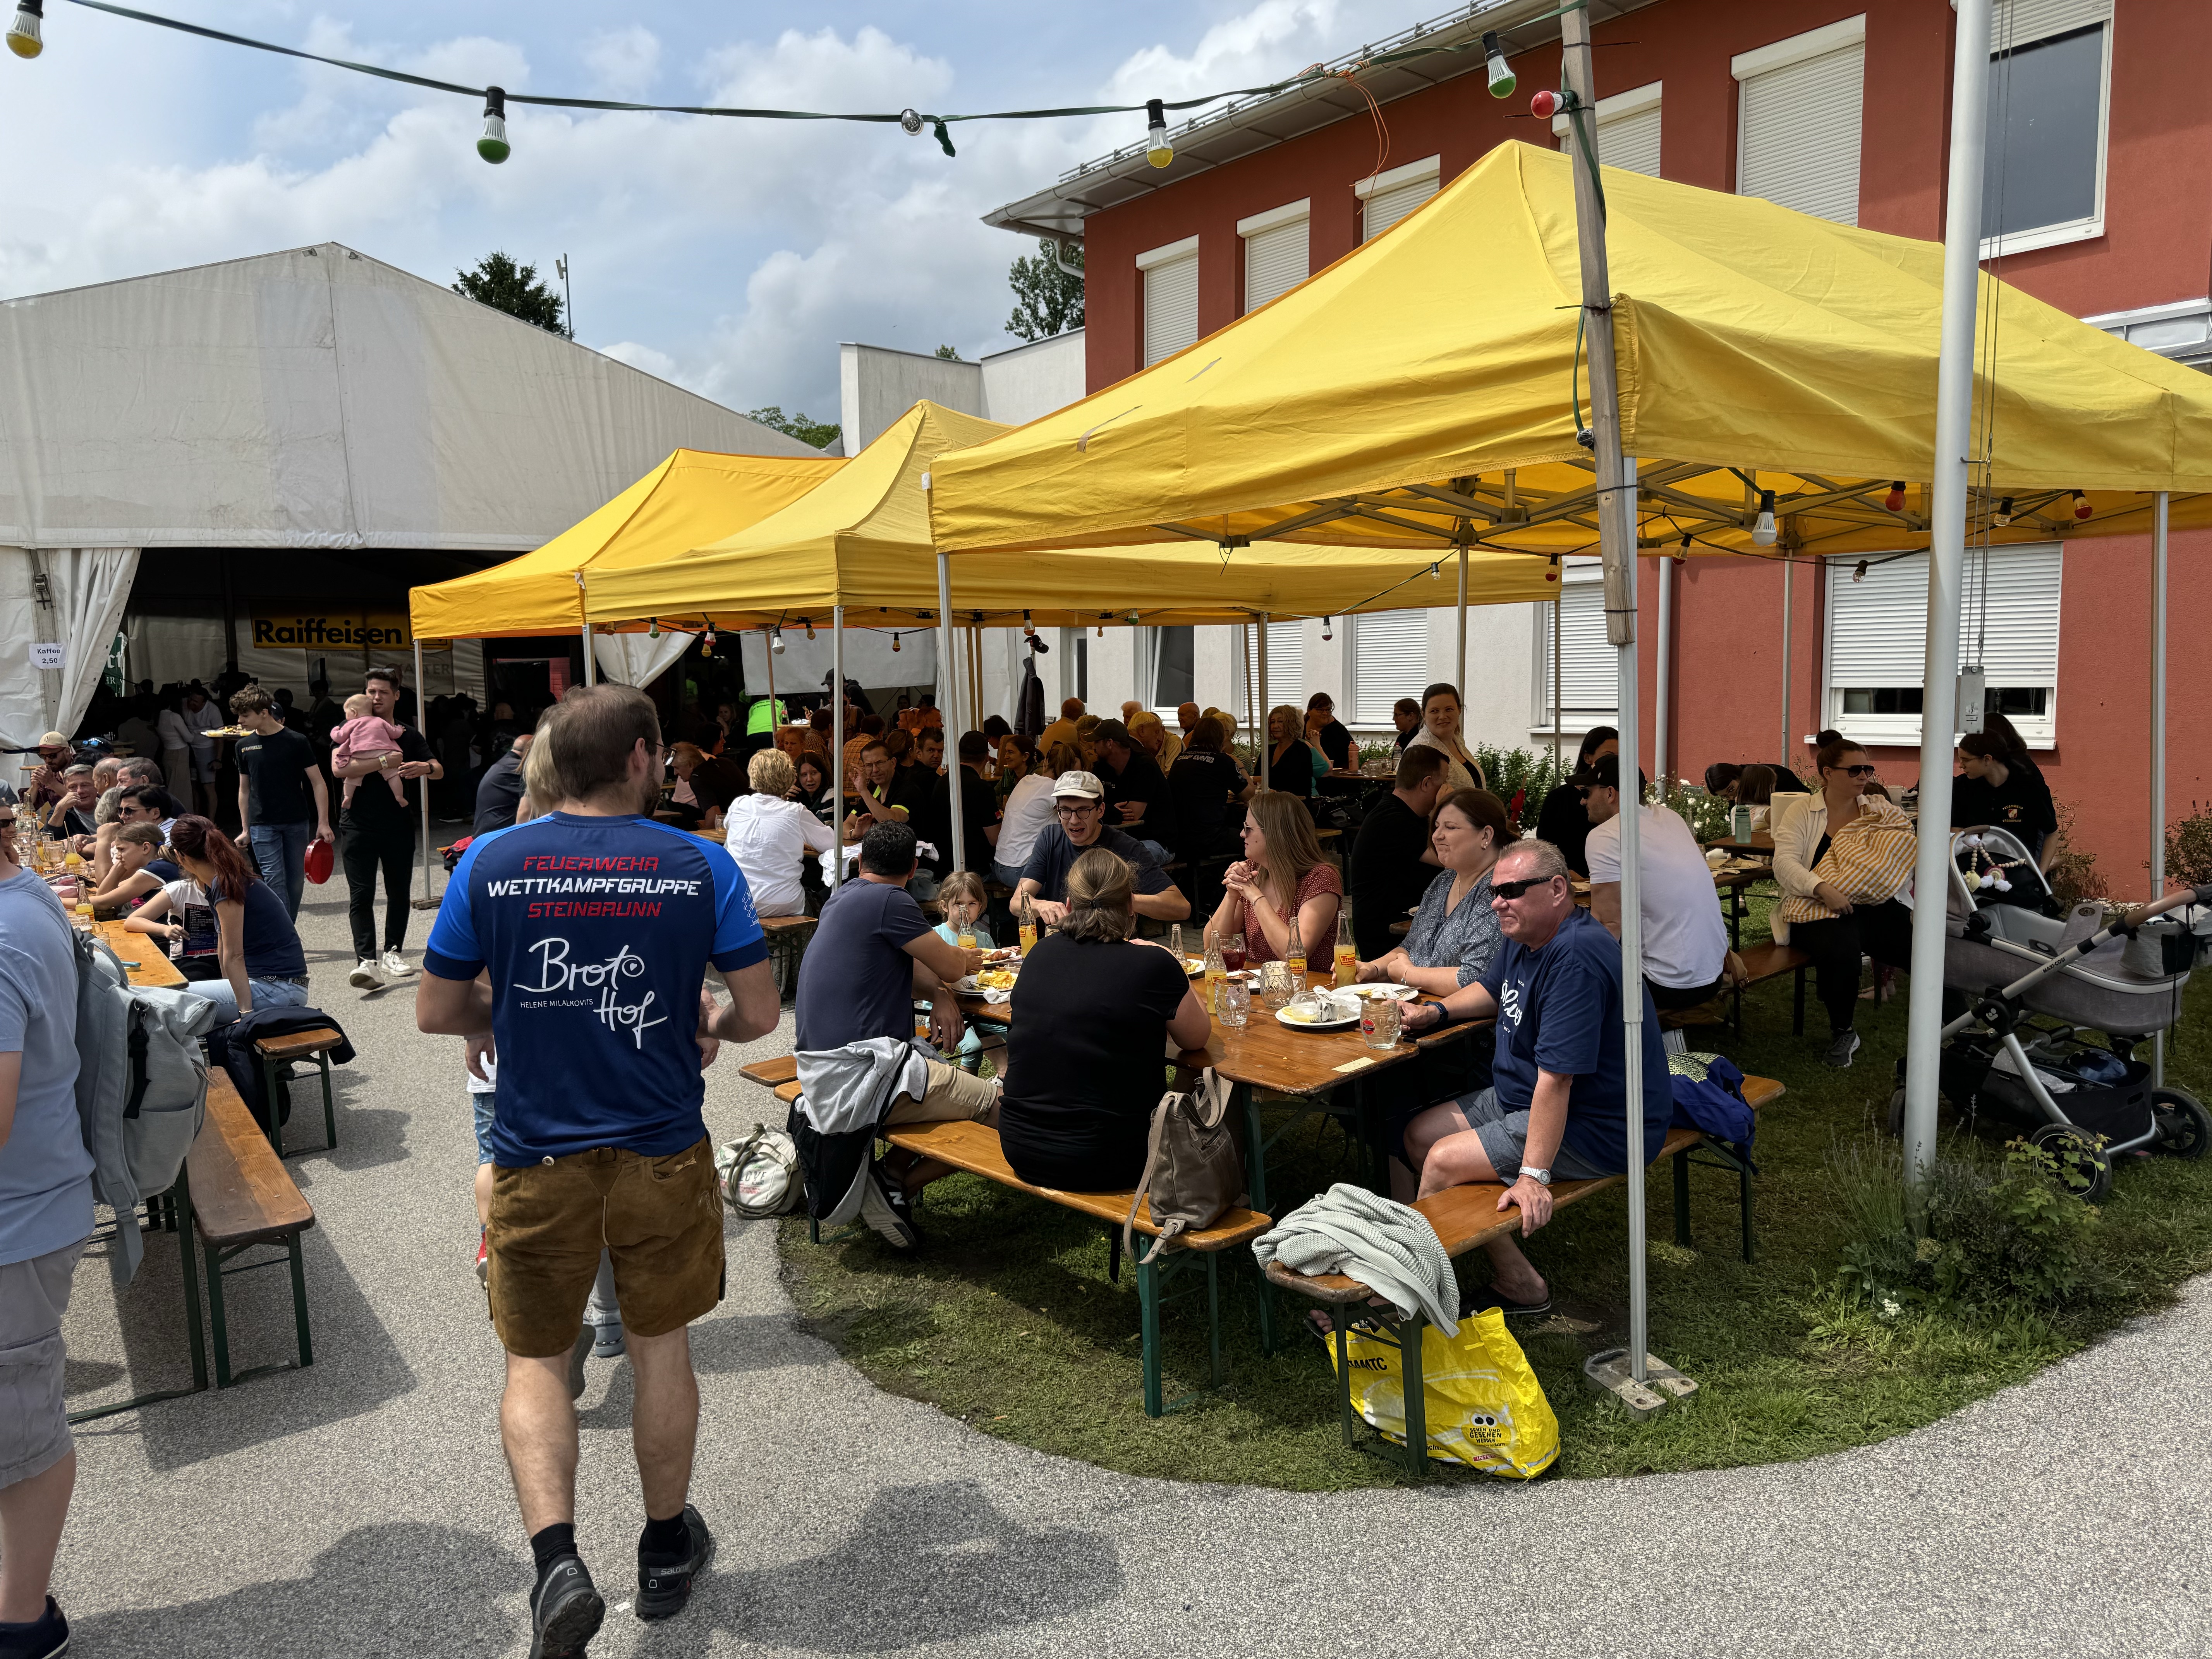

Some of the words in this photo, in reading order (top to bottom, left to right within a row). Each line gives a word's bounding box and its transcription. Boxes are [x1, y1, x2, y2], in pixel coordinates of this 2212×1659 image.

[255, 618, 402, 644] Raiffeisen
[524, 856, 659, 871] FEUERWEHR
[488, 878, 701, 897] WETTKAMPFGRUPPE
[528, 902, 662, 918] STEINBRUNN
[593, 986, 668, 1049] Hof
